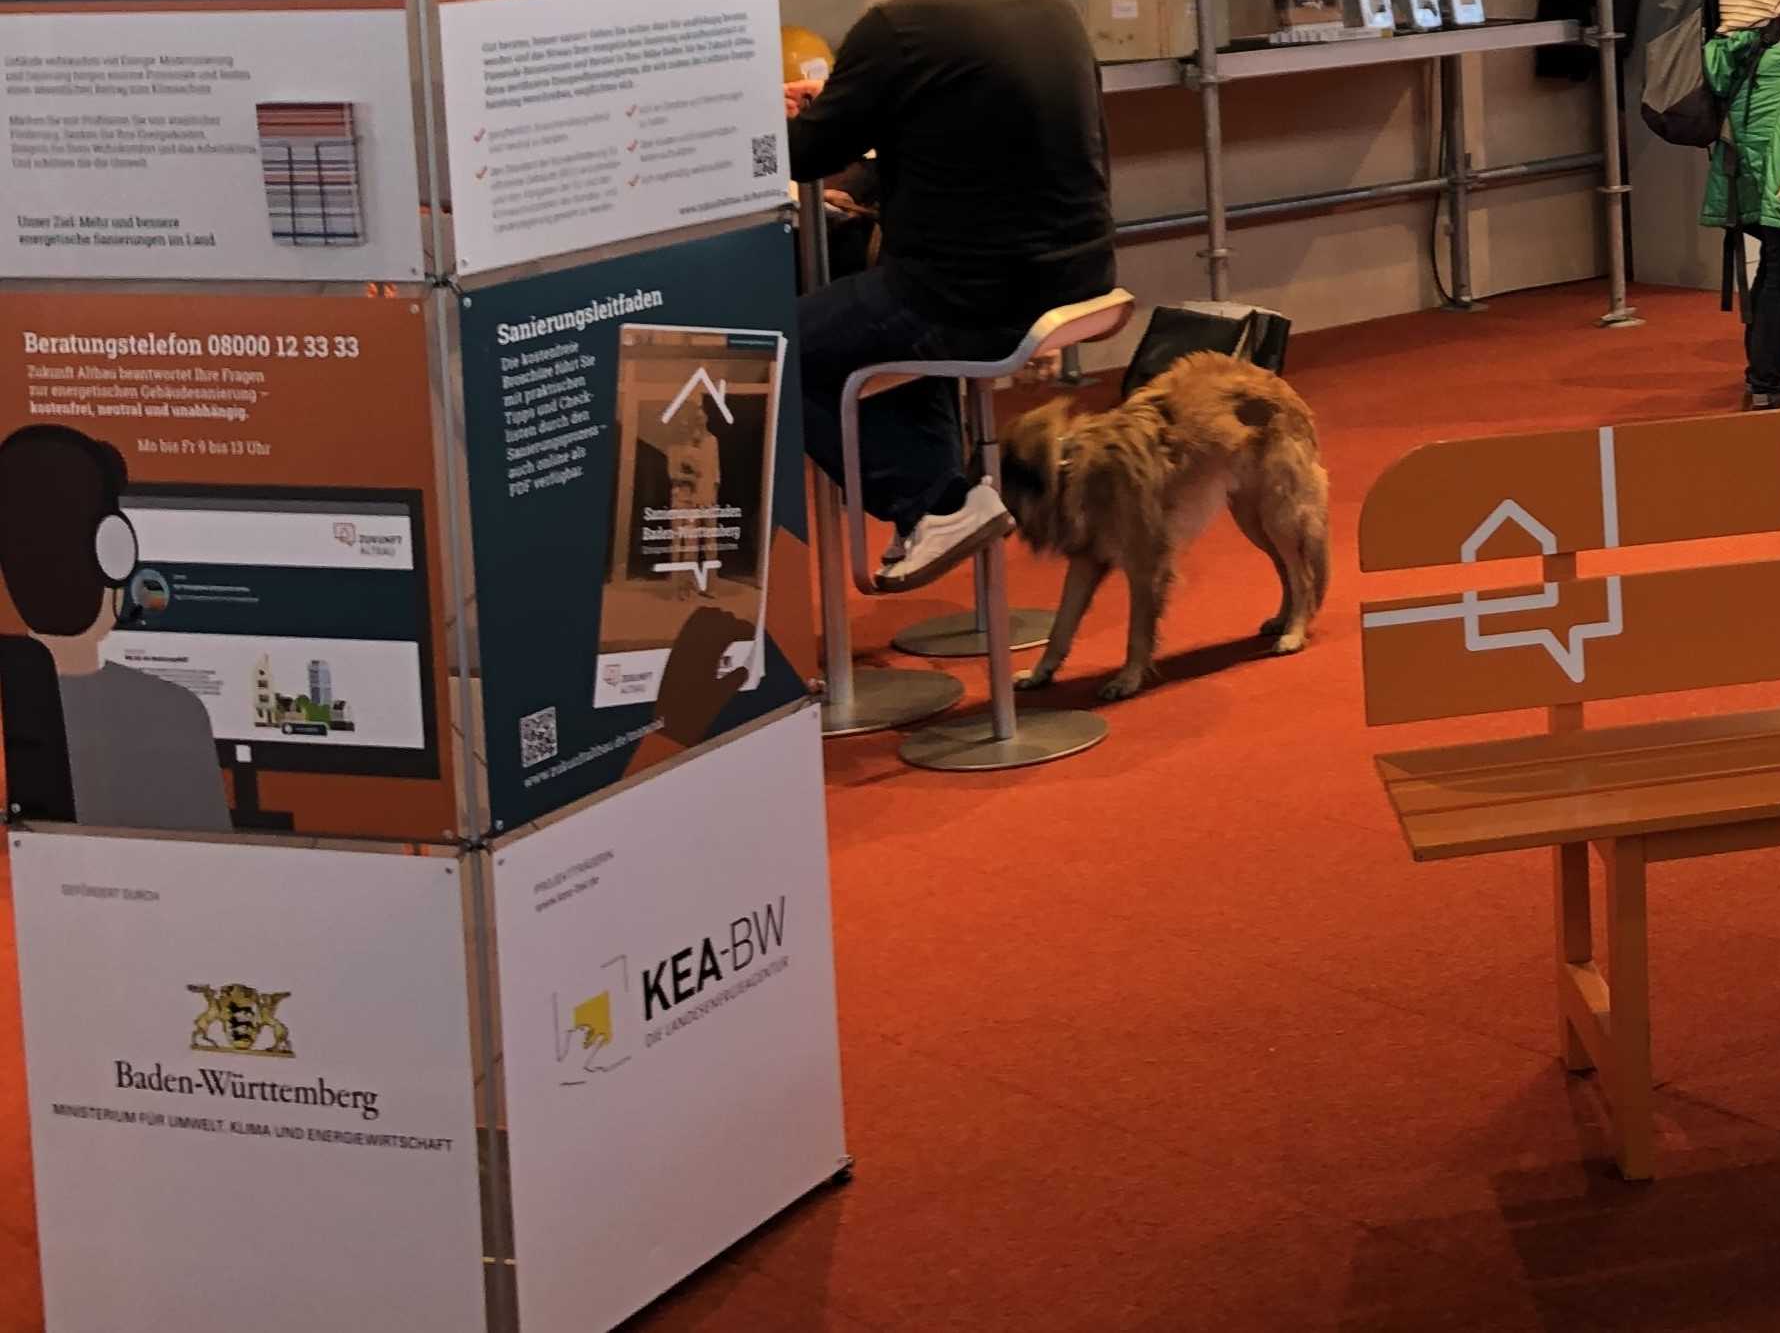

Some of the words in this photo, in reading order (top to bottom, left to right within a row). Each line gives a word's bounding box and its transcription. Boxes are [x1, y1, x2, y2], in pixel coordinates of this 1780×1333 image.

[23, 331, 202, 360] Beratungstelefon
[207, 335, 270, 357] 08000
[276, 336, 298, 357] 12
[304, 337, 329, 358] 33
[334, 337, 360, 358] 33
[497, 289, 663, 346] Sanierungsleitfaden
[642, 895, 785, 1021] KEA-BW
[114, 1060, 380, 1120] Baden-Württemberg
[53, 1103, 136, 1123] MINISTERIUM
[140, 1111, 165, 1127] FÜR
[230, 1121, 270, 1138] KLIMA
[275, 1125, 303, 1140] UND
[308, 1127, 452, 1152] ENERGIEWIRTSCHAFT
